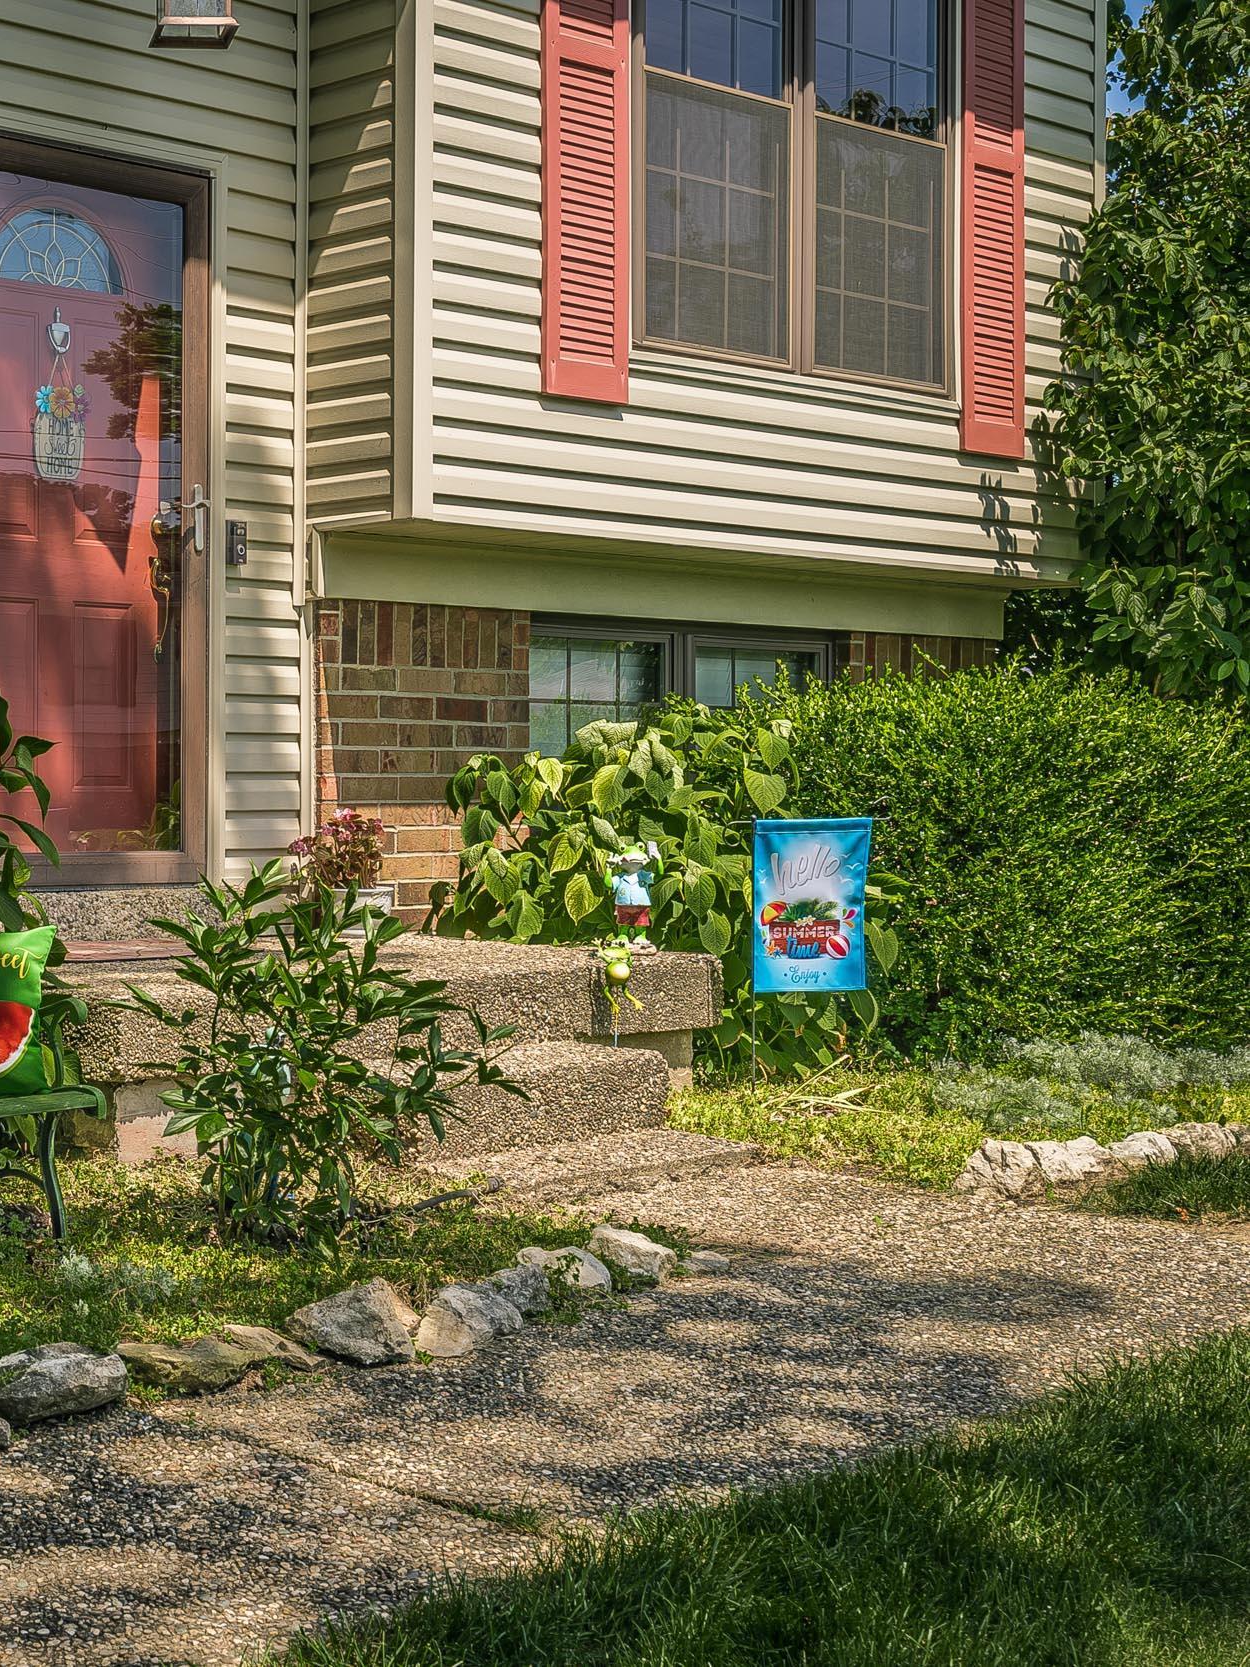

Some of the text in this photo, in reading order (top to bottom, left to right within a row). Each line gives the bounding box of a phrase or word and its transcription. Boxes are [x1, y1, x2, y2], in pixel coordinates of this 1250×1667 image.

[48, 418, 74, 436] HOME
[47, 457, 73, 475] HOME
[770, 844, 841, 896] hello
[772, 925, 835, 938] SUMMER
[788, 965, 821, 983] Enjoy
